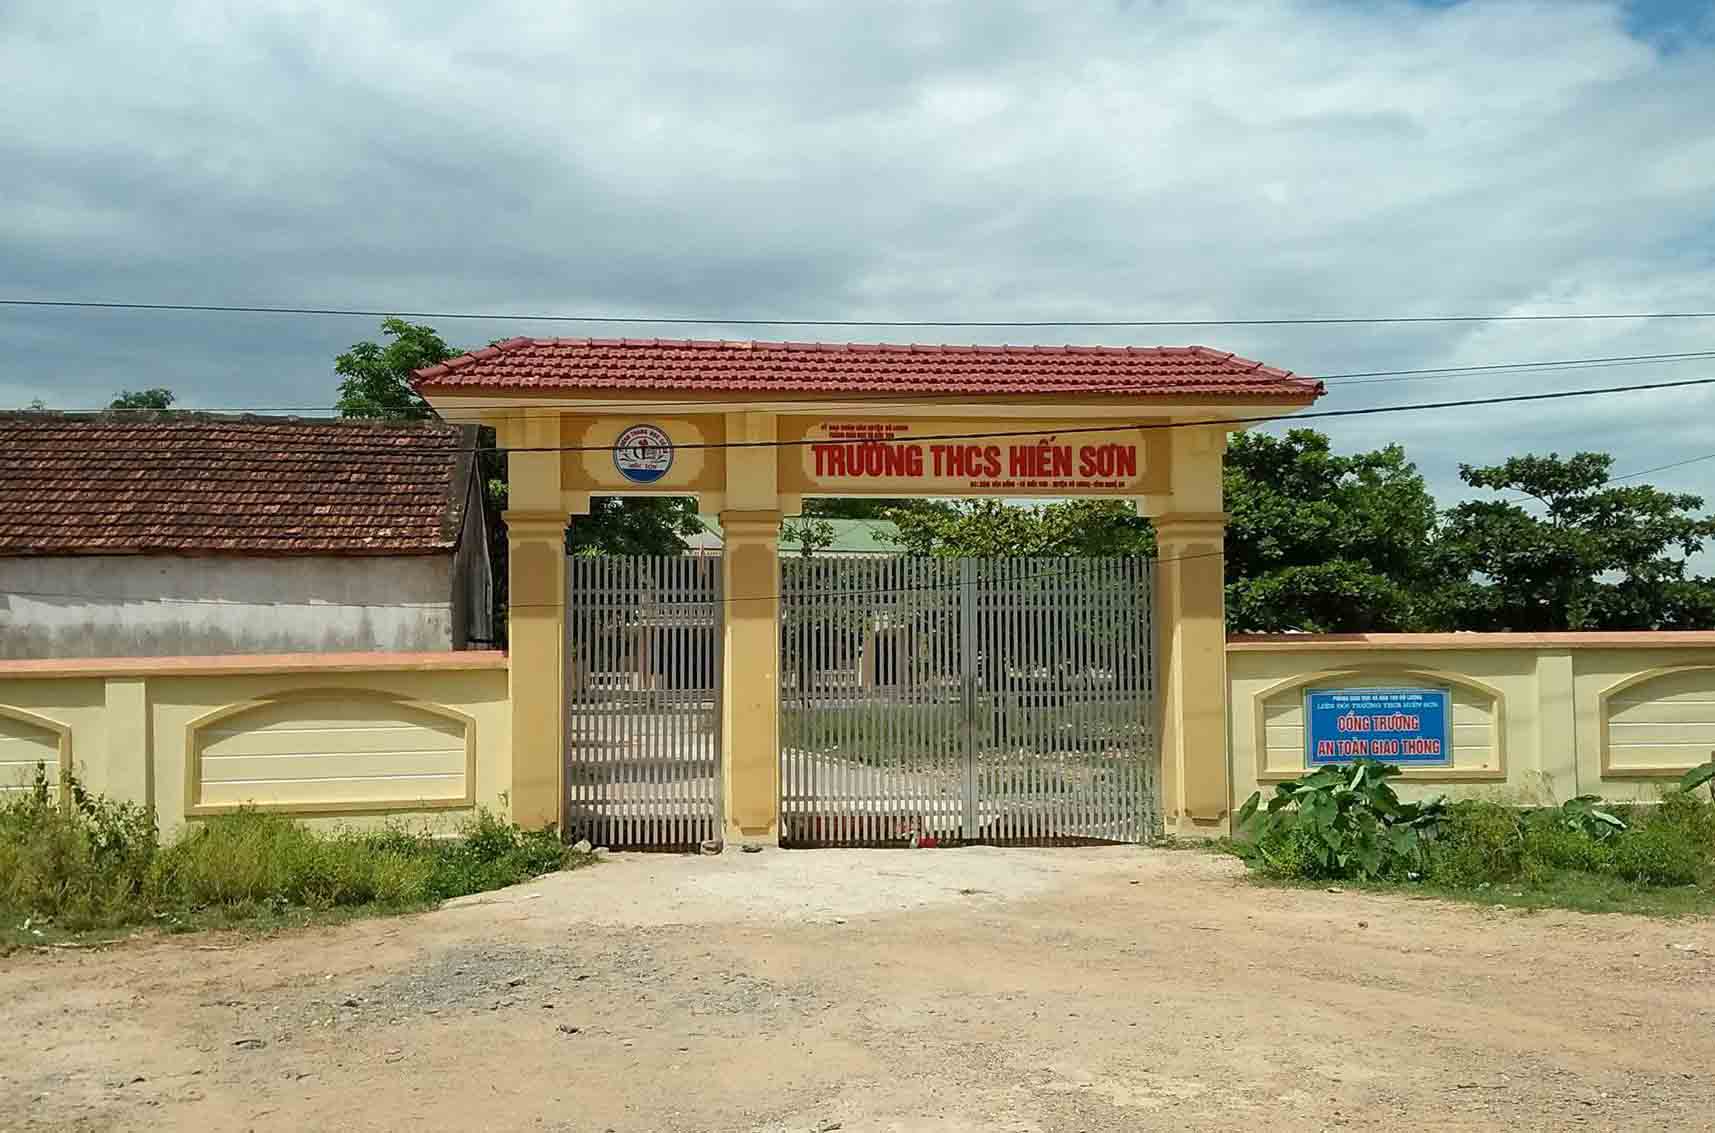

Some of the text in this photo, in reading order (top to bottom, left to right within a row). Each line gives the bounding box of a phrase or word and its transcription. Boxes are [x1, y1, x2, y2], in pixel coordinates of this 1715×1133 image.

[812, 436, 1136, 478] TRƯỜNG THCS HIẾN SƠN
[1372, 712, 1419, 732] TRƯỜNG
[1317, 736, 1440, 757] AN TOÀN GIAO THÔNG
